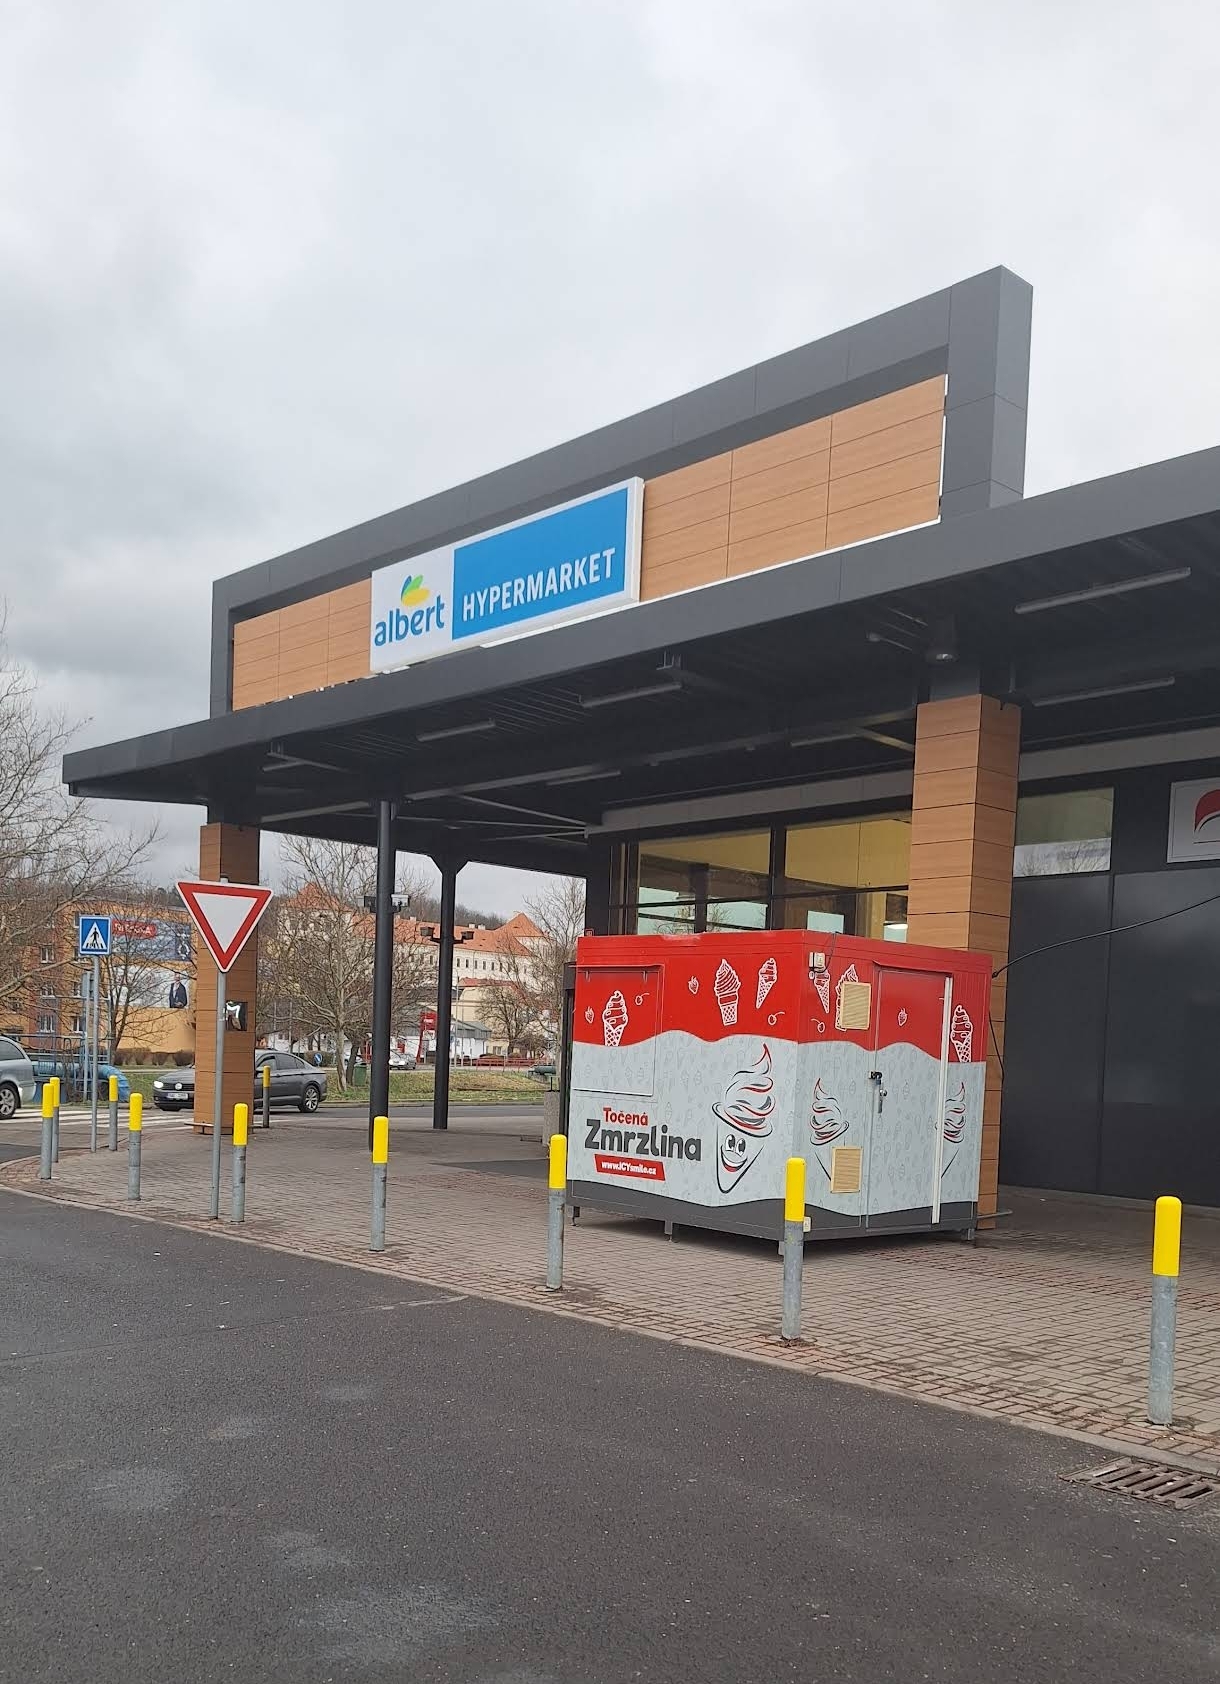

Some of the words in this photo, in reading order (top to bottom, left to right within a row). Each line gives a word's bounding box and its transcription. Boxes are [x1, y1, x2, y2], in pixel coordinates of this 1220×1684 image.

[374, 595, 445, 647] albert
[463, 547, 616, 622] HYPERMARKET
[603, 1107, 648, 1126] Točená
[585, 1118, 702, 1161] Zmrzlina
